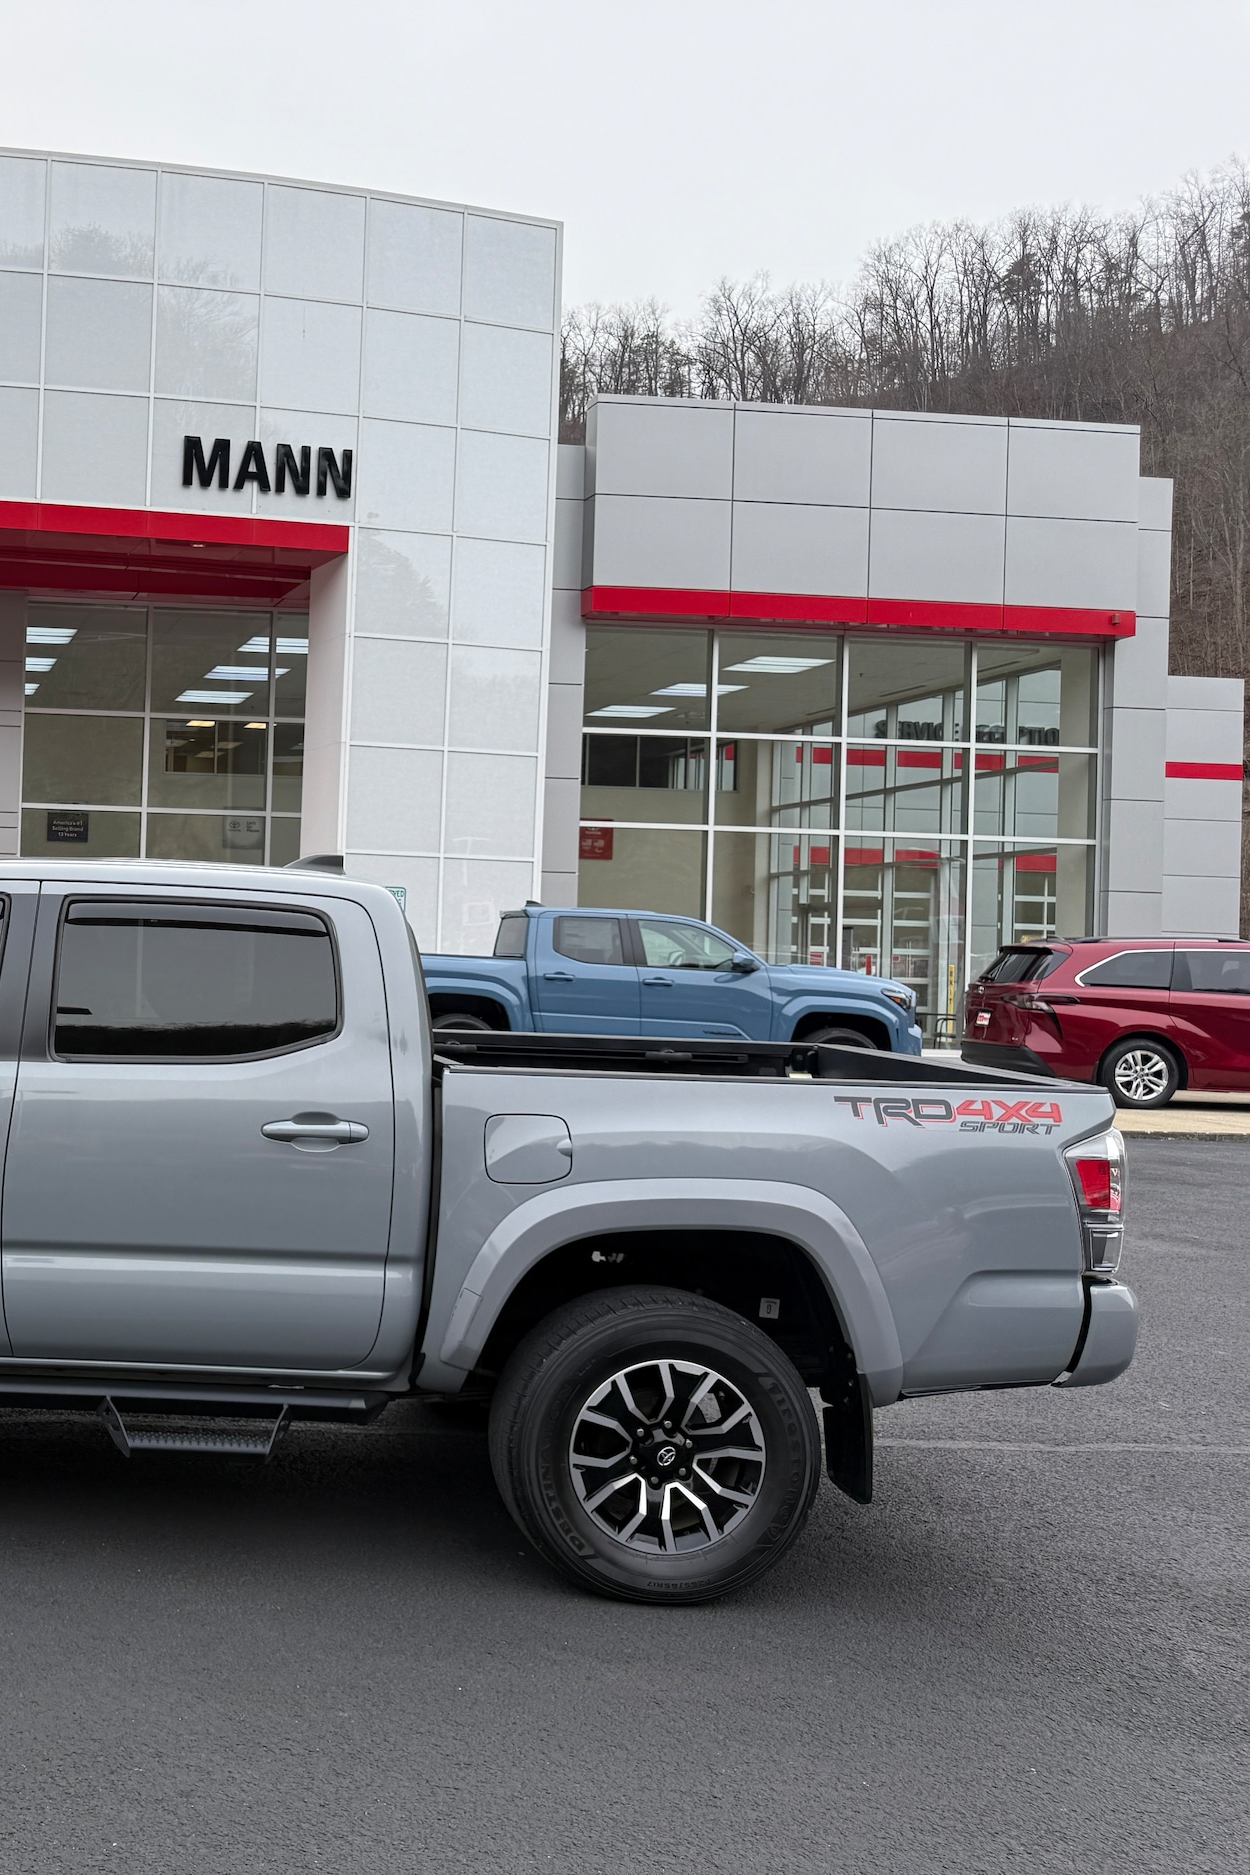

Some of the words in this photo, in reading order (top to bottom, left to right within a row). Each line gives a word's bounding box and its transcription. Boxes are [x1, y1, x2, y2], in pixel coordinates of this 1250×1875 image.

[182, 435, 353, 499] MANN
[874, 720, 960, 741] SRVIC
[834, 1096, 956, 1129] TRD
[959, 1121, 1061, 1135] SPORT
